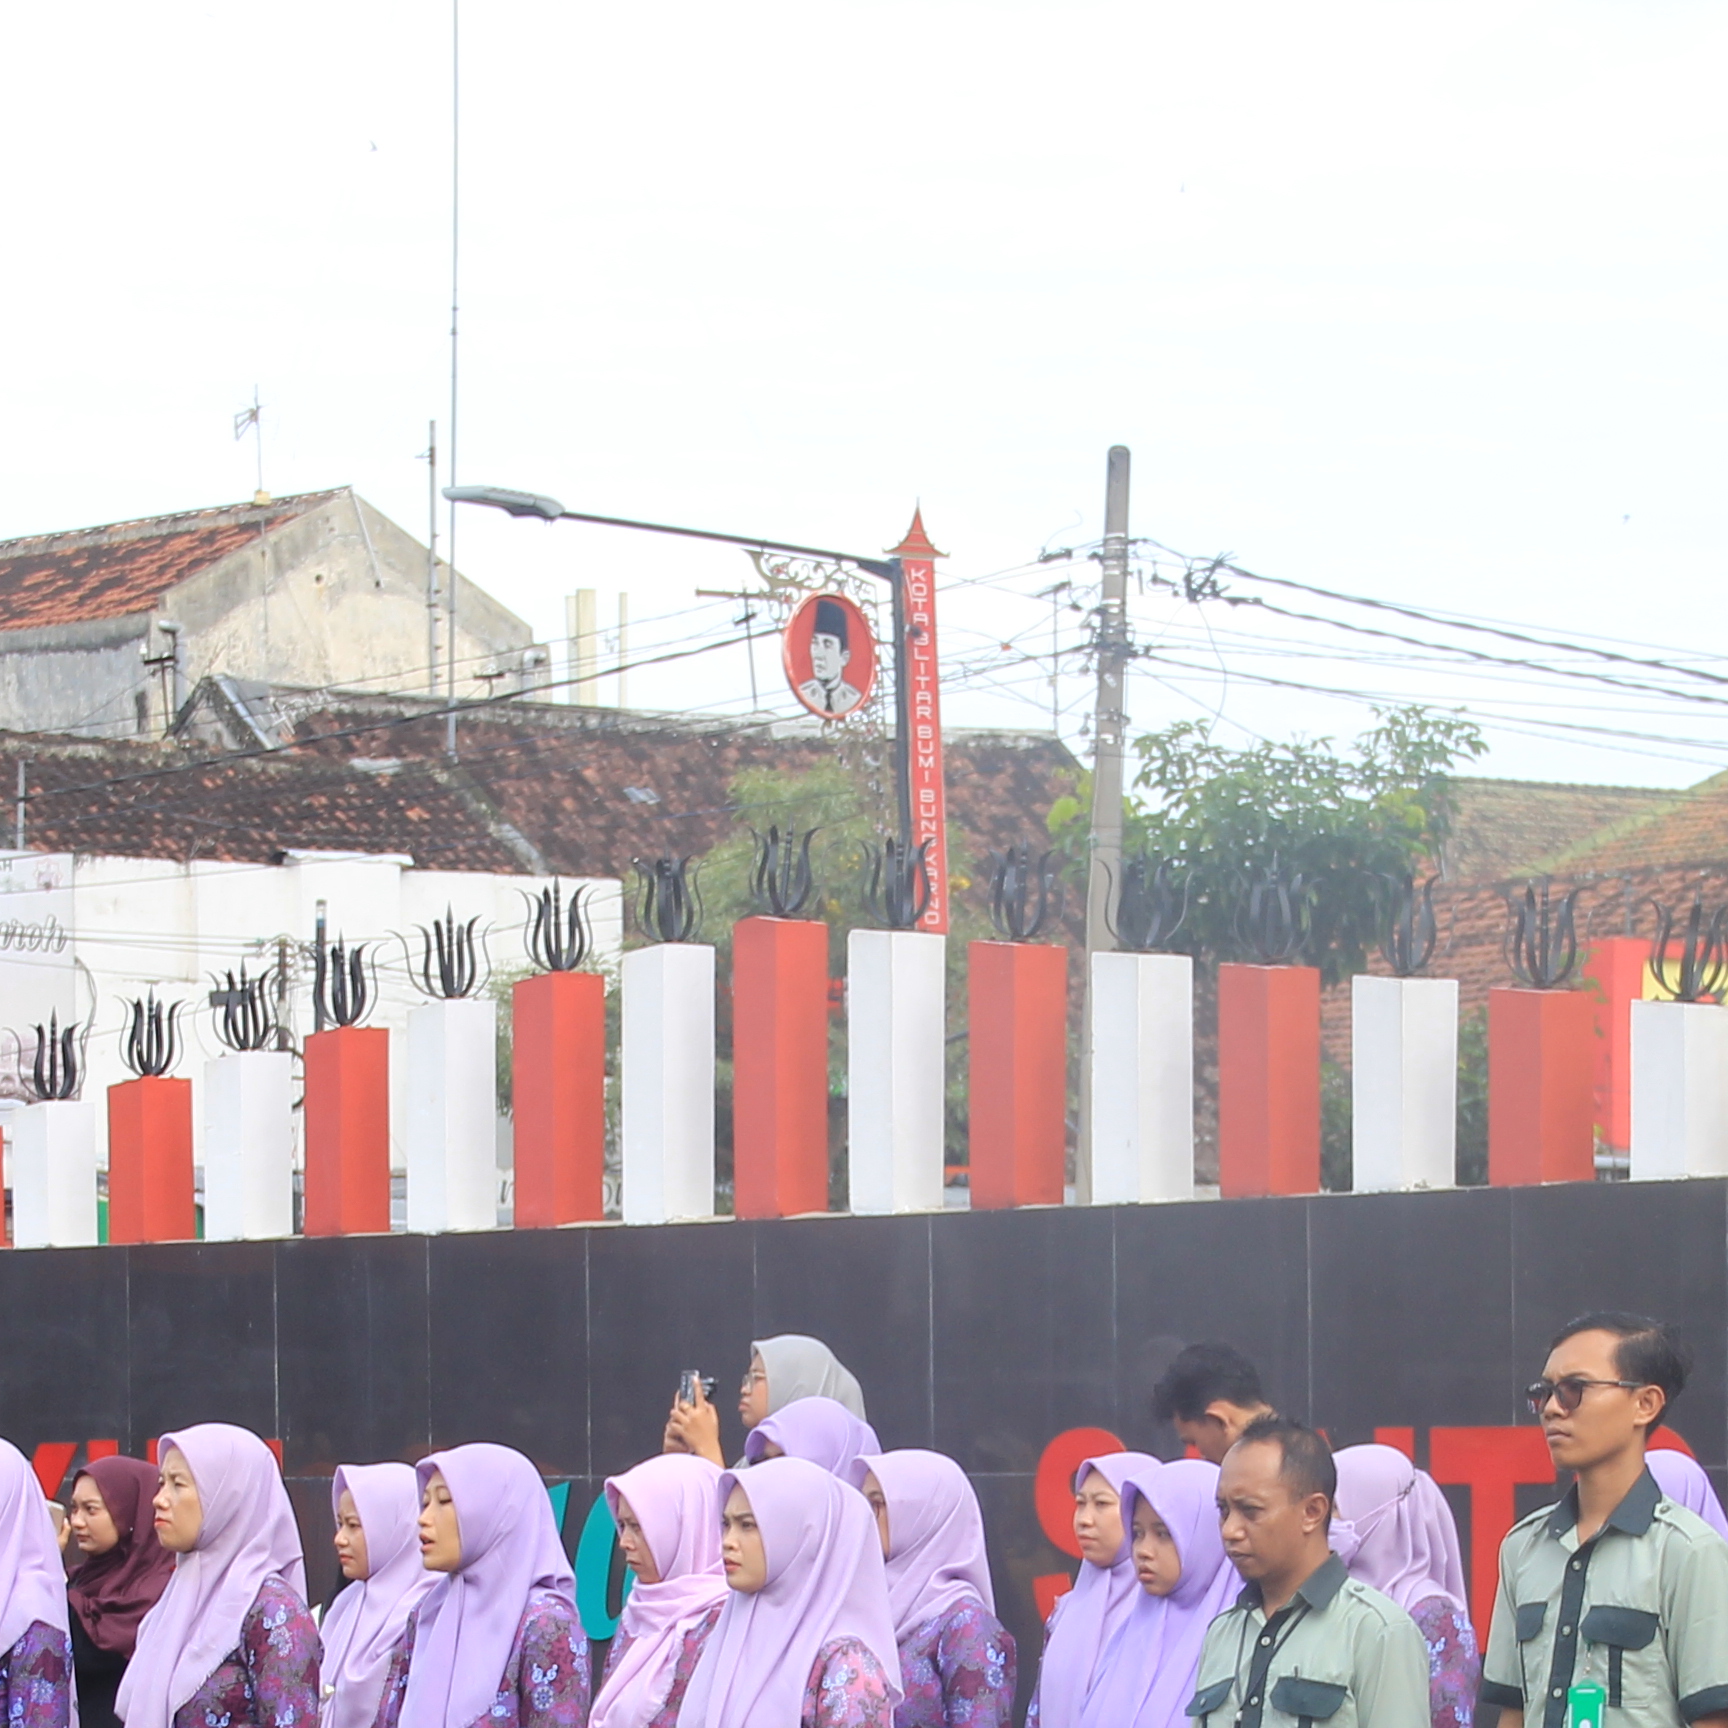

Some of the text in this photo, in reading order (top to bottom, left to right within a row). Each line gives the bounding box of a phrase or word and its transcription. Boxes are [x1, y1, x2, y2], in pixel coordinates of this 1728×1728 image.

[910, 568, 929, 627] KOTA
[913, 631, 933, 720] BLITAR
[917, 725, 934, 783] BUMI
